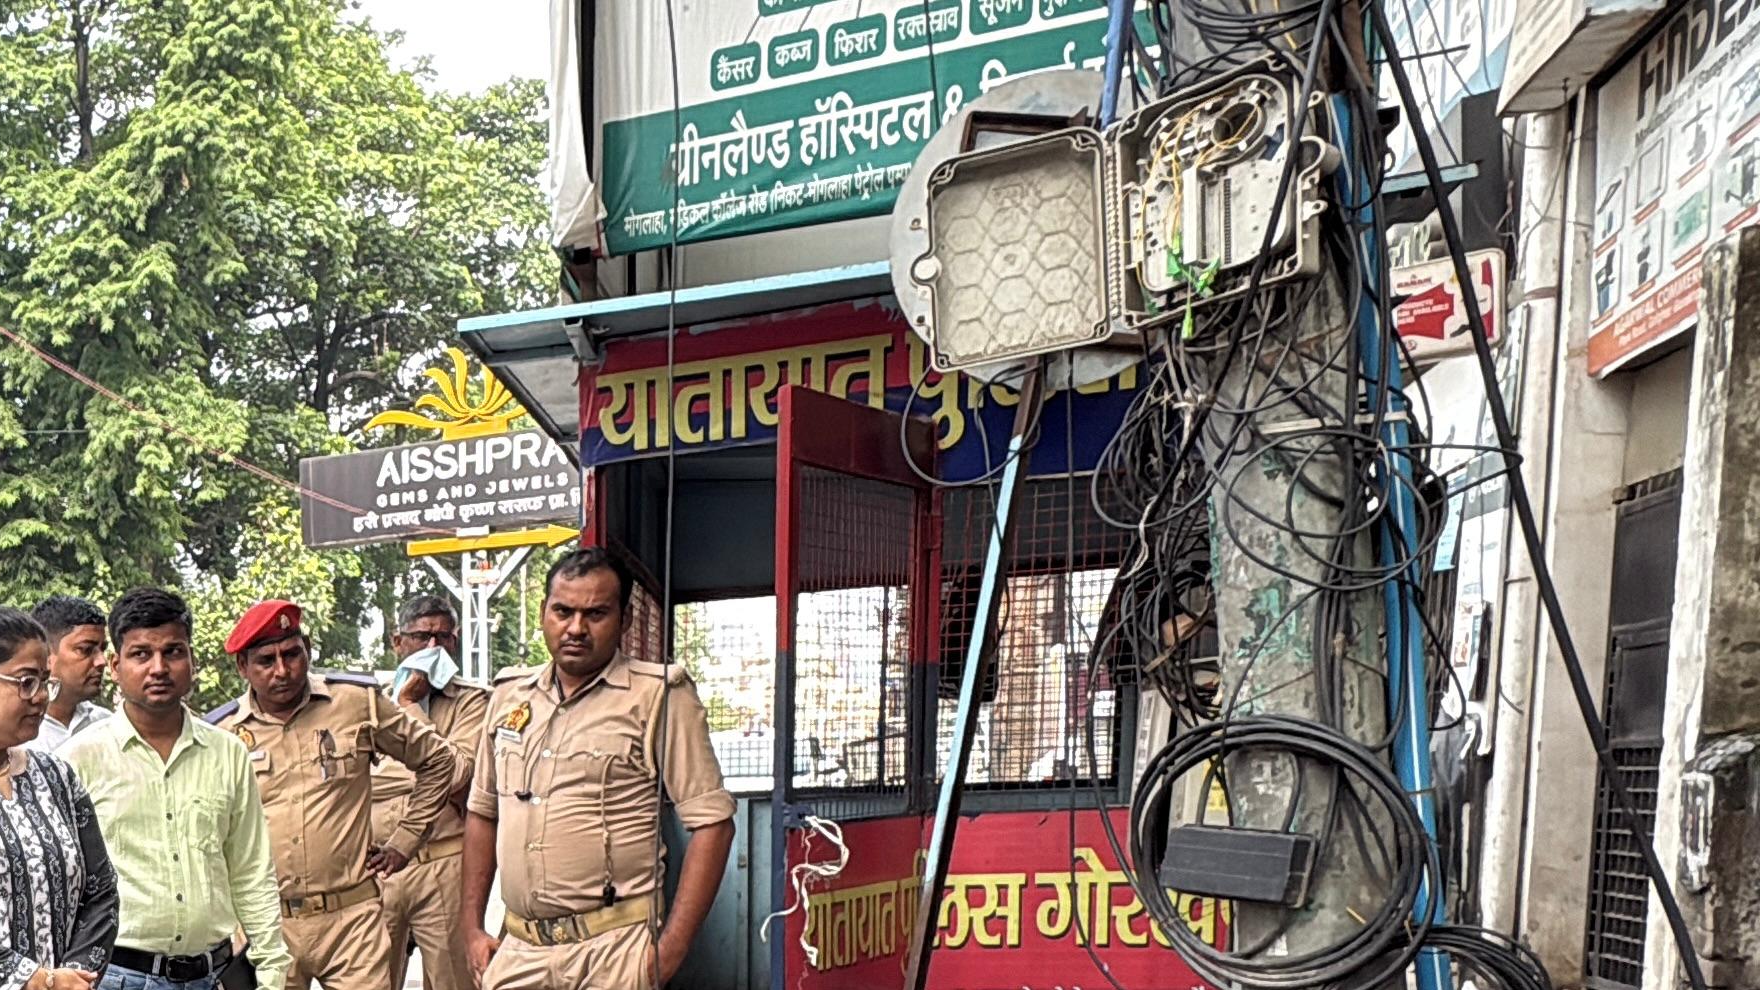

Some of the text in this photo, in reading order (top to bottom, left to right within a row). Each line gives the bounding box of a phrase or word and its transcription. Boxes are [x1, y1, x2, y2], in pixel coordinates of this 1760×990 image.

[774, 39, 813, 67] कब्ज
[835, 28, 879, 59] फिशर
[798, 91, 934, 166] हॉस्पिटल
[597, 333, 893, 450] यातायात
[376, 433, 568, 487] AISSHPRA
[376, 472, 568, 508] GEMS AND JEWELS
[804, 881, 897, 971] यातायात
